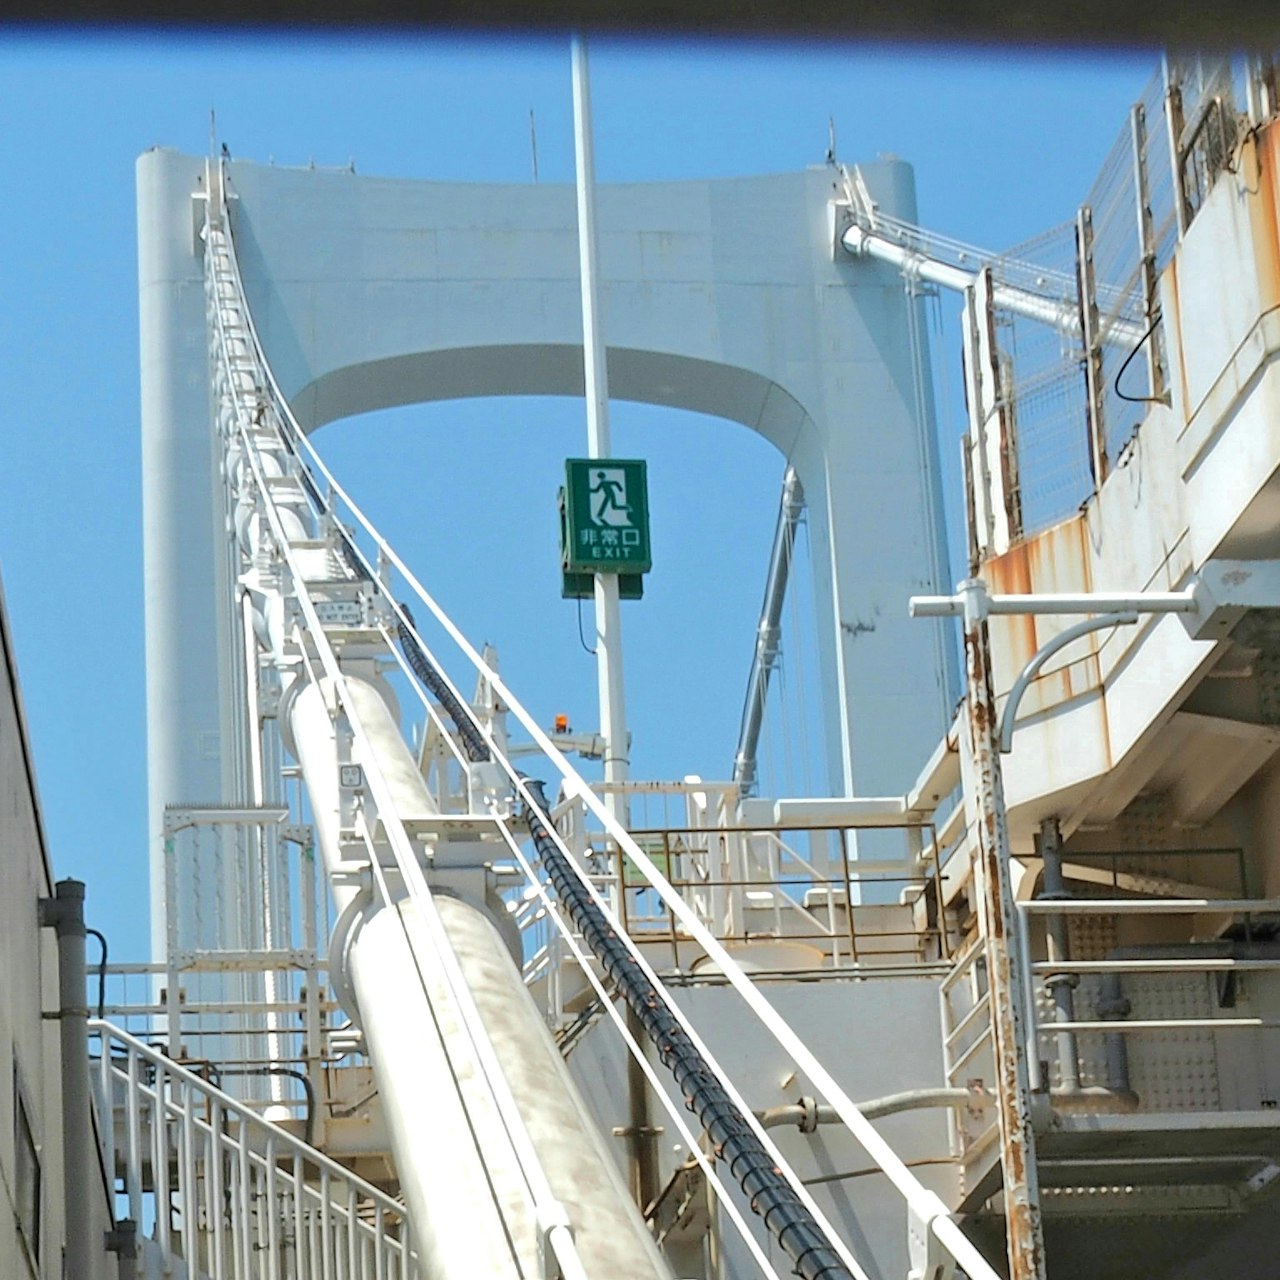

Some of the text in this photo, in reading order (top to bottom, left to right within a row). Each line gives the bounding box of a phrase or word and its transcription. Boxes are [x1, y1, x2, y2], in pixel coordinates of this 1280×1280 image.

[580, 528, 640, 546] 非常口
[592, 547, 631, 558] EXIT
